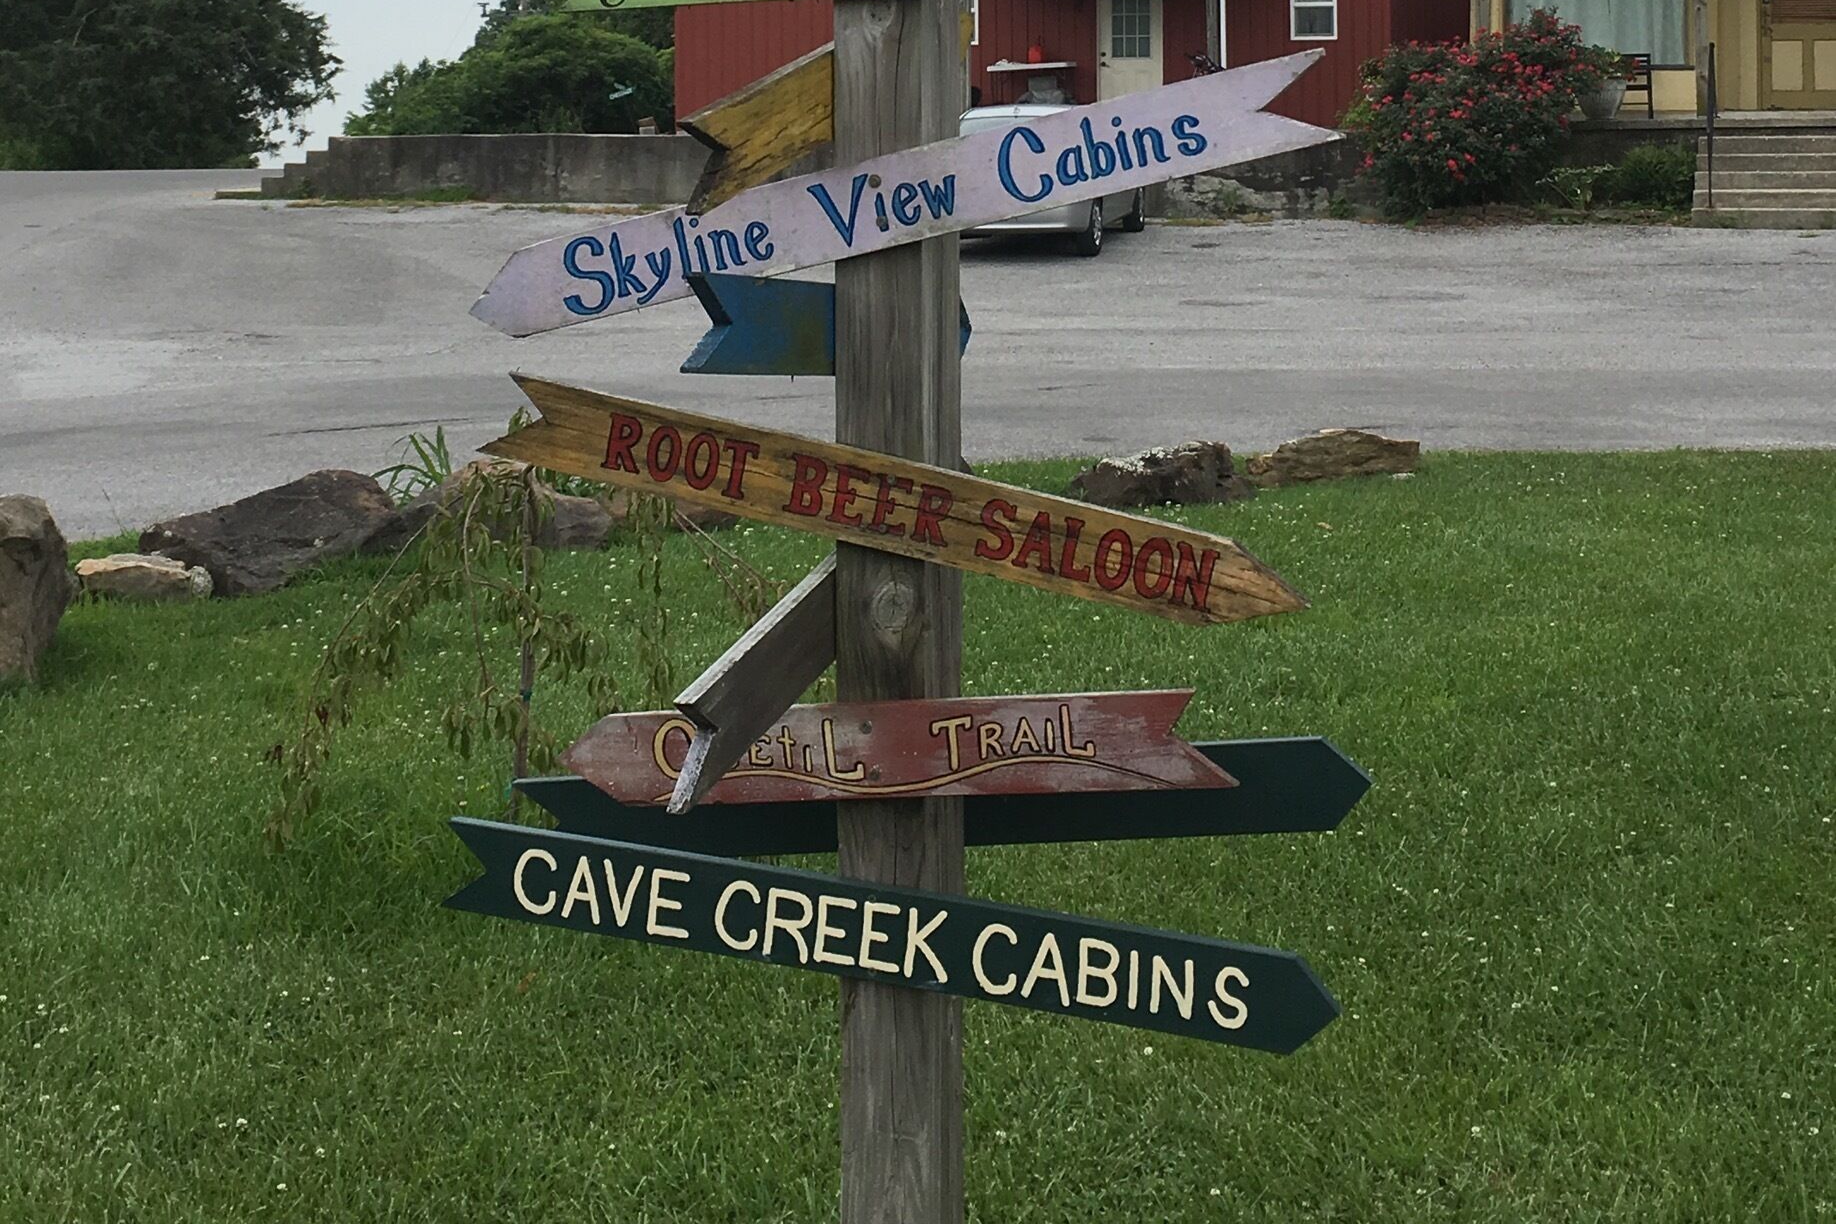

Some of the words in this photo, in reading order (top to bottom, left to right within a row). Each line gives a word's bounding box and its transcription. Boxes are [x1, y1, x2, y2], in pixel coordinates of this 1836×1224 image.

[563, 216, 774, 316] Skyline
[807, 173, 956, 247] View
[998, 114, 1207, 203] Cabins
[601, 412, 760, 500] ROOT
[782, 452, 953, 547] BEER
[974, 498, 1220, 613] SALOON
[930, 703, 1096, 772] TRAIL
[514, 849, 690, 939] CAVE
[715, 880, 948, 983] CREEK
[972, 923, 1250, 1030] CABINS
